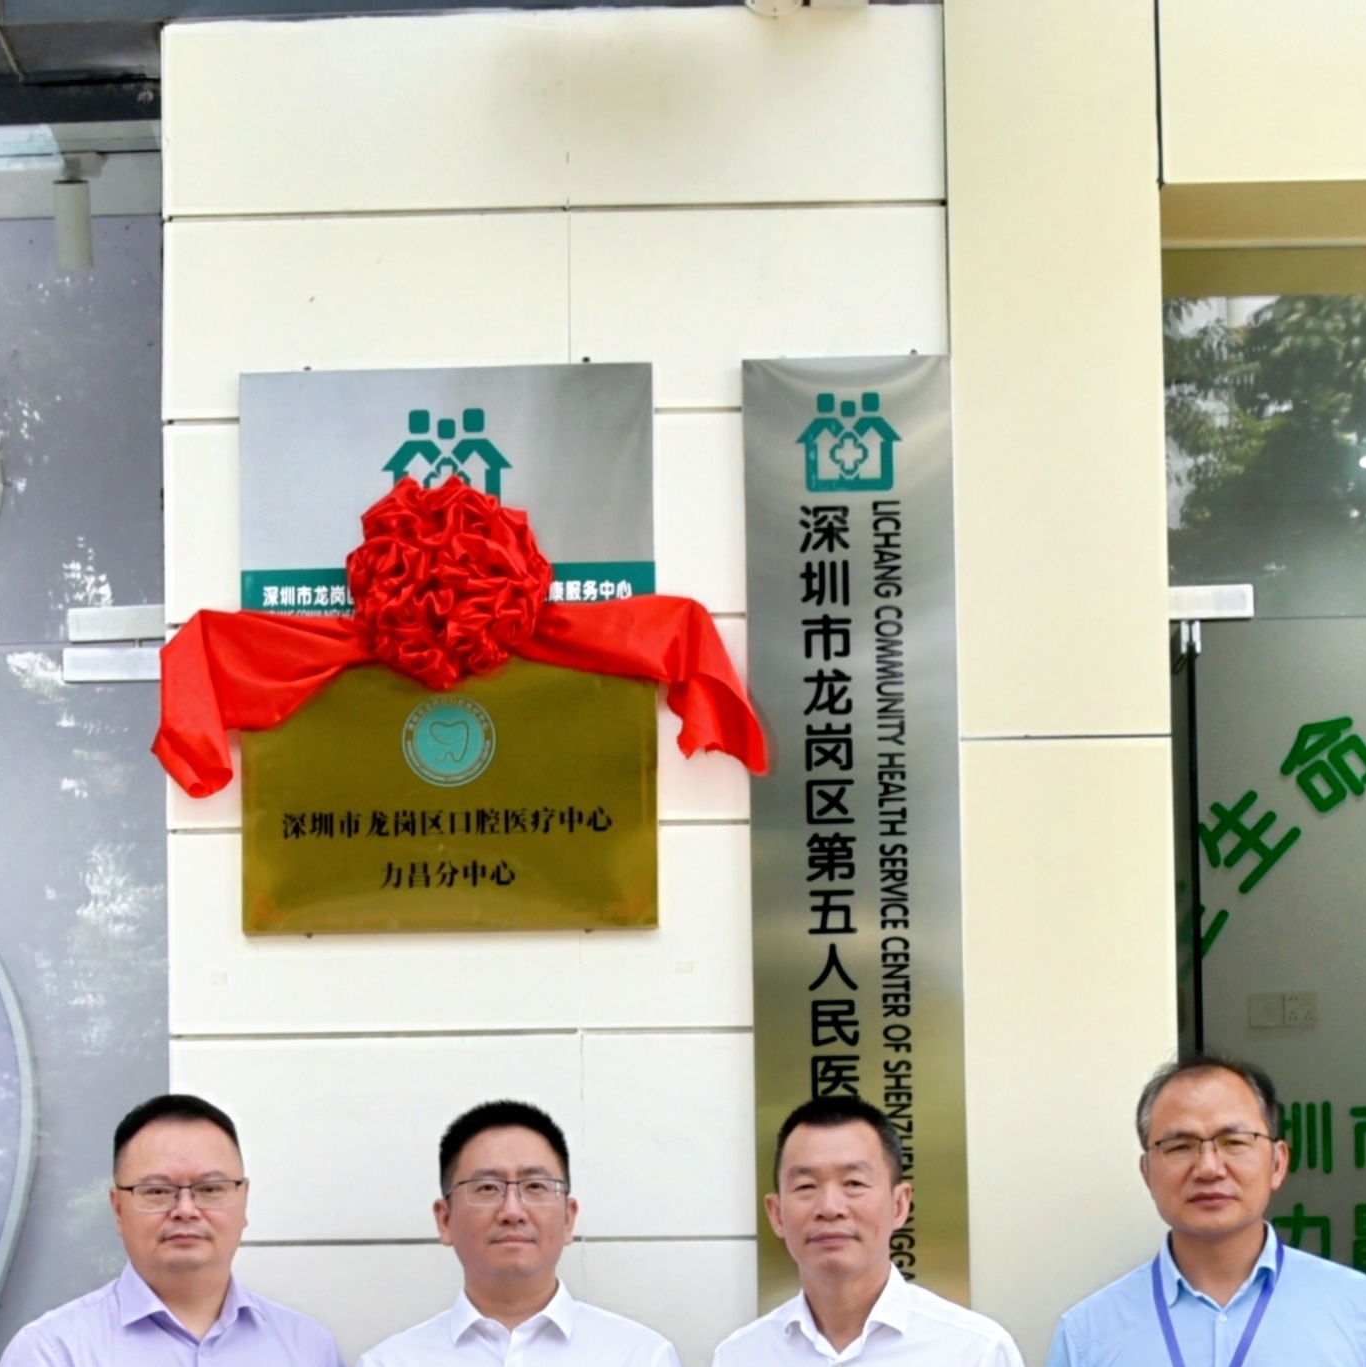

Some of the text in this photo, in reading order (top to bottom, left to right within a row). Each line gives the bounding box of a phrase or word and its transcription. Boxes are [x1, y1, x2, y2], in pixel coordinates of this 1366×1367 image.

[544, 580, 633, 602] 康服务中心
[872, 501, 902, 599] LICHANG
[874, 605, 906, 745] COMMUNITY
[282, 806, 613, 840] 深圳市龙岗区口腔医疗中心
[799, 504, 861, 1100] 深圳市龙岗区第五人民医
[877, 752, 908, 836] HEALTH
[380, 860, 516, 889] 力昌分中心
[879, 843, 909, 929] SERVICE
[881, 937, 911, 1019] CENTER
[883, 1025, 912, 1053] OF
